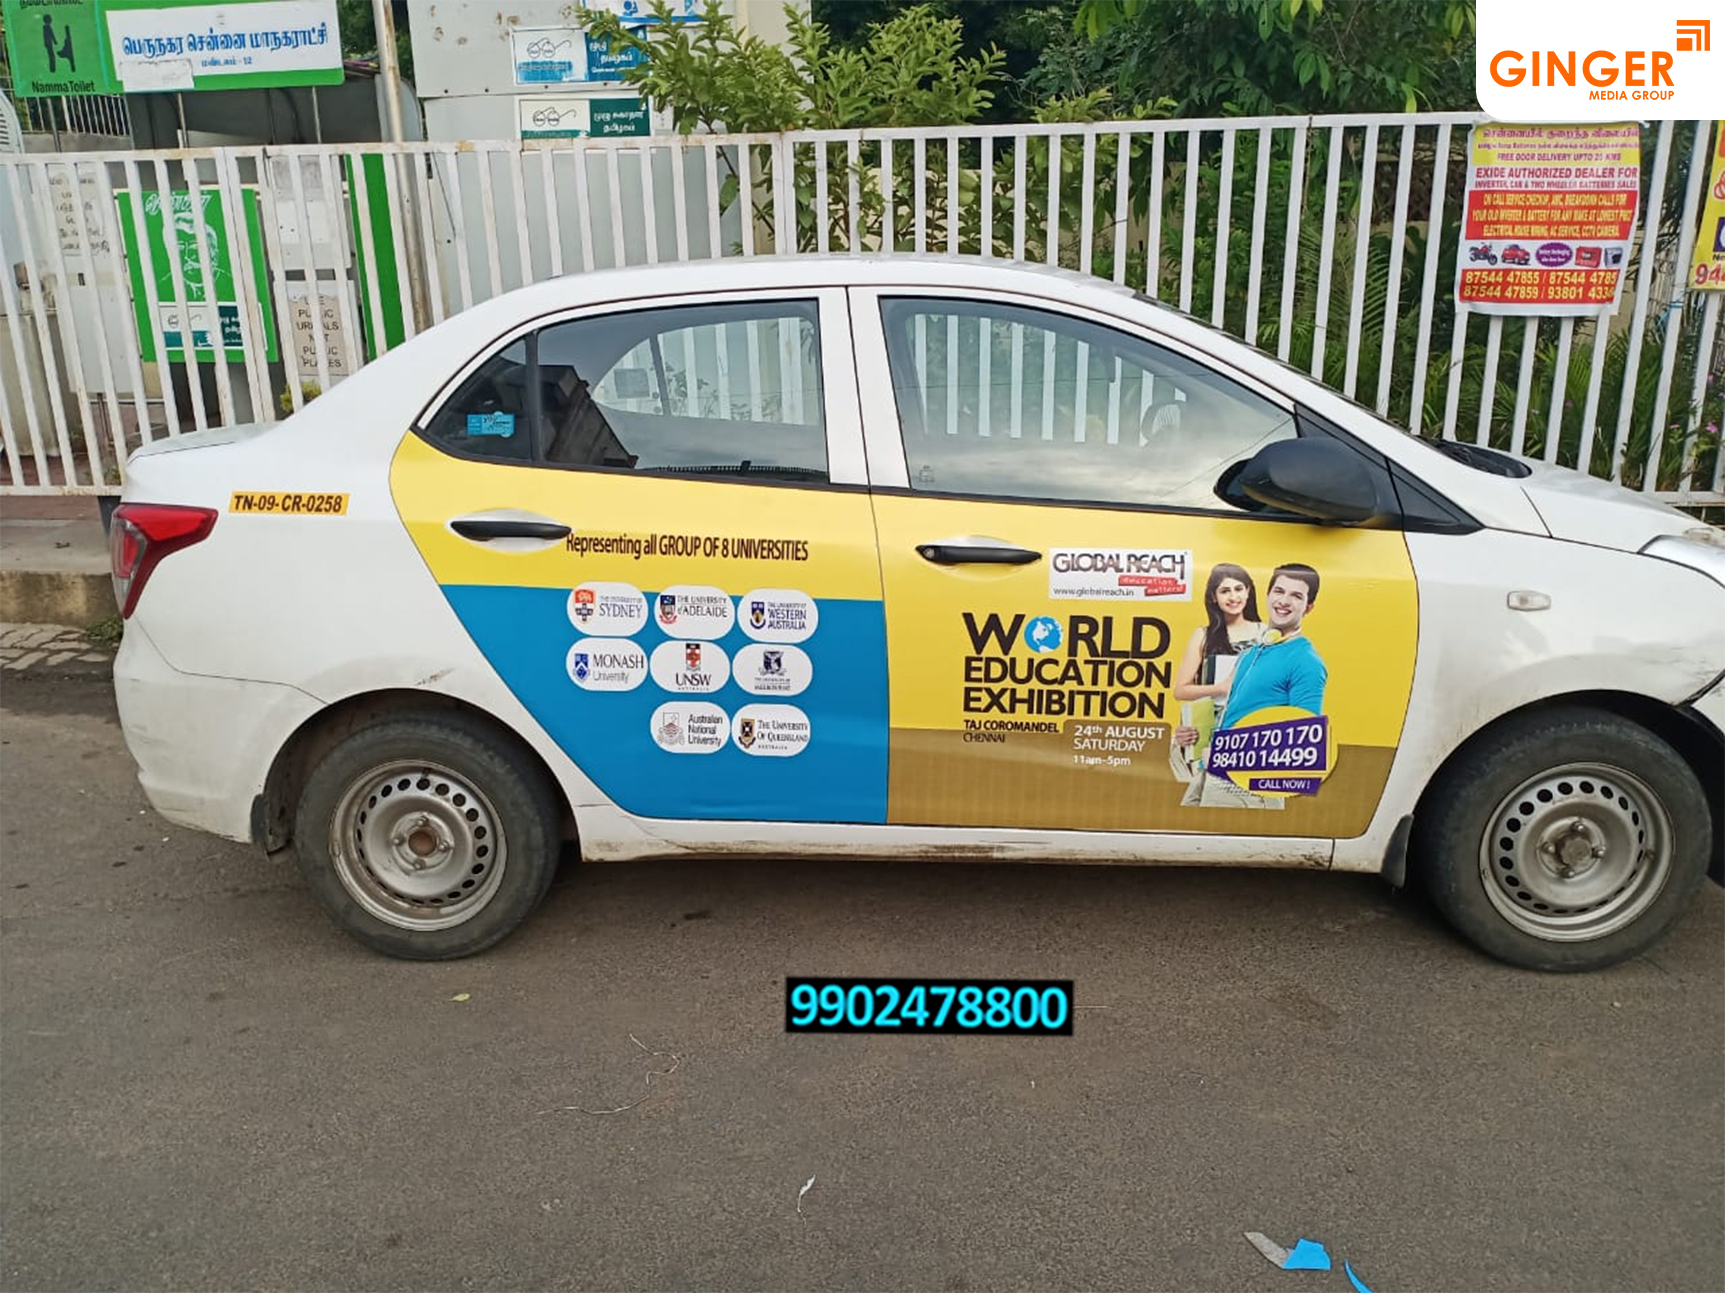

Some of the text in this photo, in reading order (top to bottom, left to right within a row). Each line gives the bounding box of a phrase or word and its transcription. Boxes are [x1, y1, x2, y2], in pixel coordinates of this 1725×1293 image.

[188, 27, 246, 51] சென்னை
[250, 22, 328, 51] மாநகராட்சி
[32, 81, 95, 93] Namma Toilet
[1498, 153, 1514, 161] FREE
[1516, 153, 1536, 161] DOOR
[1537, 153, 1571, 161] DELIVERY
[1573, 153, 1593, 161] UPTO
[1476, 167, 1638, 179] EXIDE AUTHORIZED DEALER FOR
[1531, 181, 1545, 189] TWO
[1466, 271, 1503, 284] 87544
[1507, 271, 1540, 284] 47855
[1550, 271, 1586, 285] 87544
[1464, 286, 1500, 298] 87544
[1505, 286, 1539, 299] 47859
[567, 534, 809, 561] Representing all GROUP OF 8 UNIVERSITIES
[1053, 553, 1185, 580] GLOBAL REACH
[1053, 588, 1134, 597] www.globalreach.in
[677, 595, 727, 604] THE UNIVERSITY
[599, 603, 643, 618] SYDNEY
[683, 606, 728, 618] ADELAIDE
[768, 608, 807, 620] WESTERN
[768, 620, 807, 630] AUSTRALIA
[593, 654, 644, 669] MONASH
[593, 671, 629, 683] University
[964, 656, 1172, 688] EDUCATION
[676, 672, 712, 686] UNSW
[963, 687, 1165, 719] EXHIBITION
[688, 714, 723, 724] Australian
[758, 720, 769, 729] THE
[688, 725, 716, 734] National
[964, 719, 1059, 733] TAJ COROMANDEL
[1074, 725, 1165, 739] 24th AUGUST
[688, 735, 721, 747] University
[963, 733, 1005, 743] CHENNAI
[1215, 724, 1323, 751] 9107 170 170
[1073, 738, 1146, 752] SATURDAY
[1212, 747, 1318, 767] 98410 14499
[1258, 779, 1280, 789] CALL
